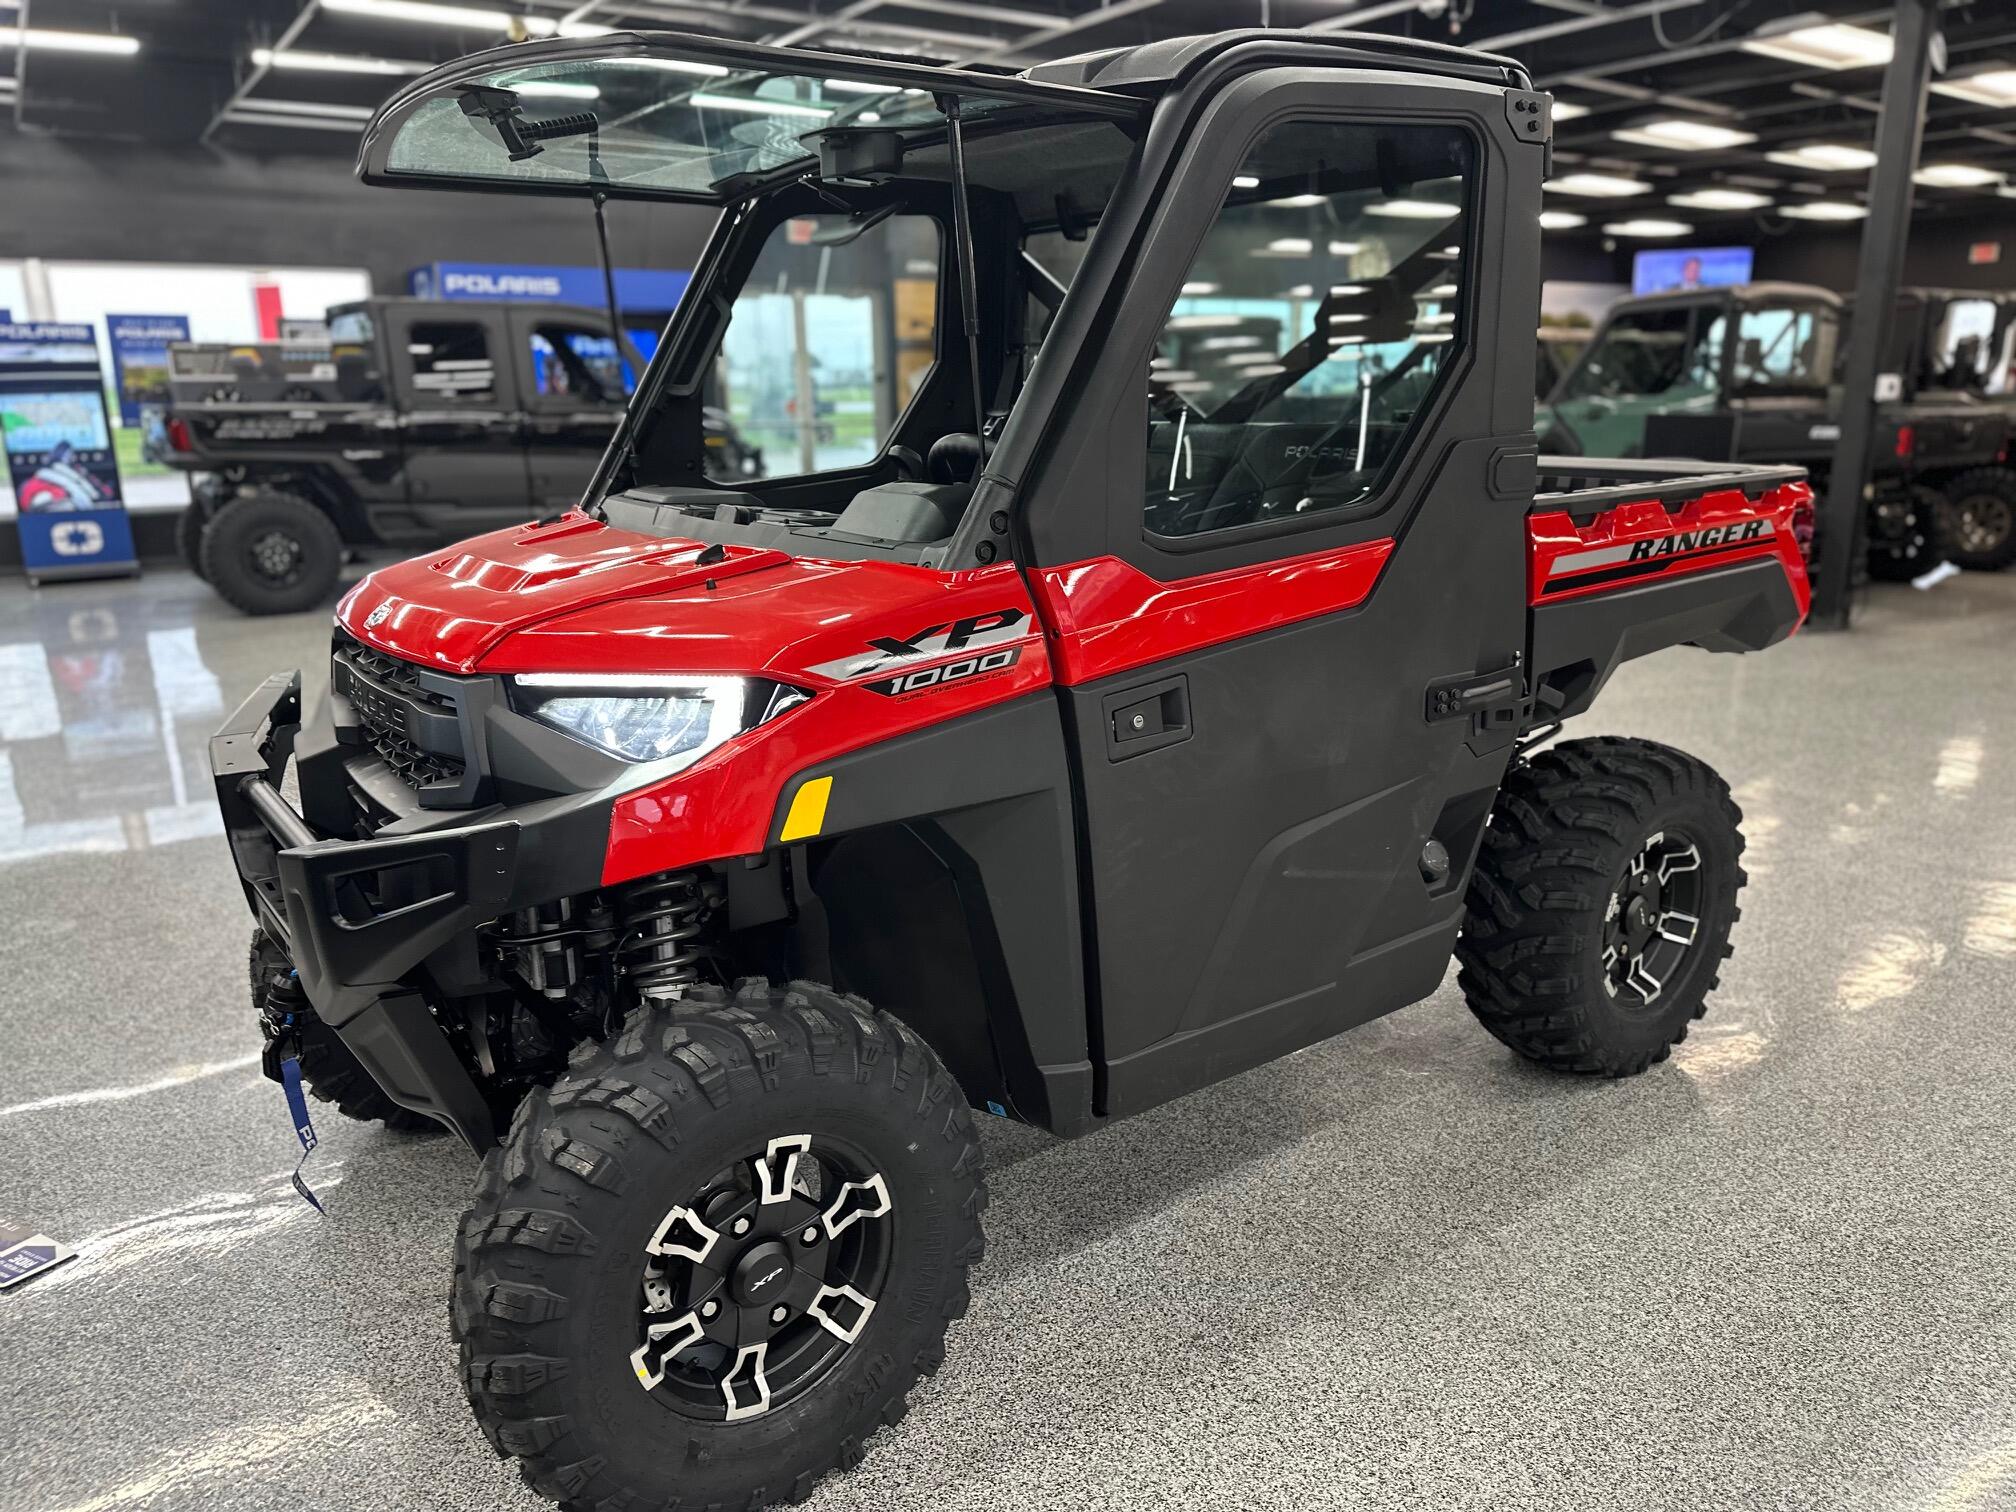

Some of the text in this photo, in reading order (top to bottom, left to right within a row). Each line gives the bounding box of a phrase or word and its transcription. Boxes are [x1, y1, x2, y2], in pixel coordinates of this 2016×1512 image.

[445, 273, 562, 296] POLARIS
[1628, 519, 1765, 562] RANGER
[846, 607, 1025, 678] XP
[889, 649, 1015, 695] 1000
[895, 691, 926, 704] DUAL
[991, 668, 1015, 679] CAM
[750, 1267, 784, 1292] XP
